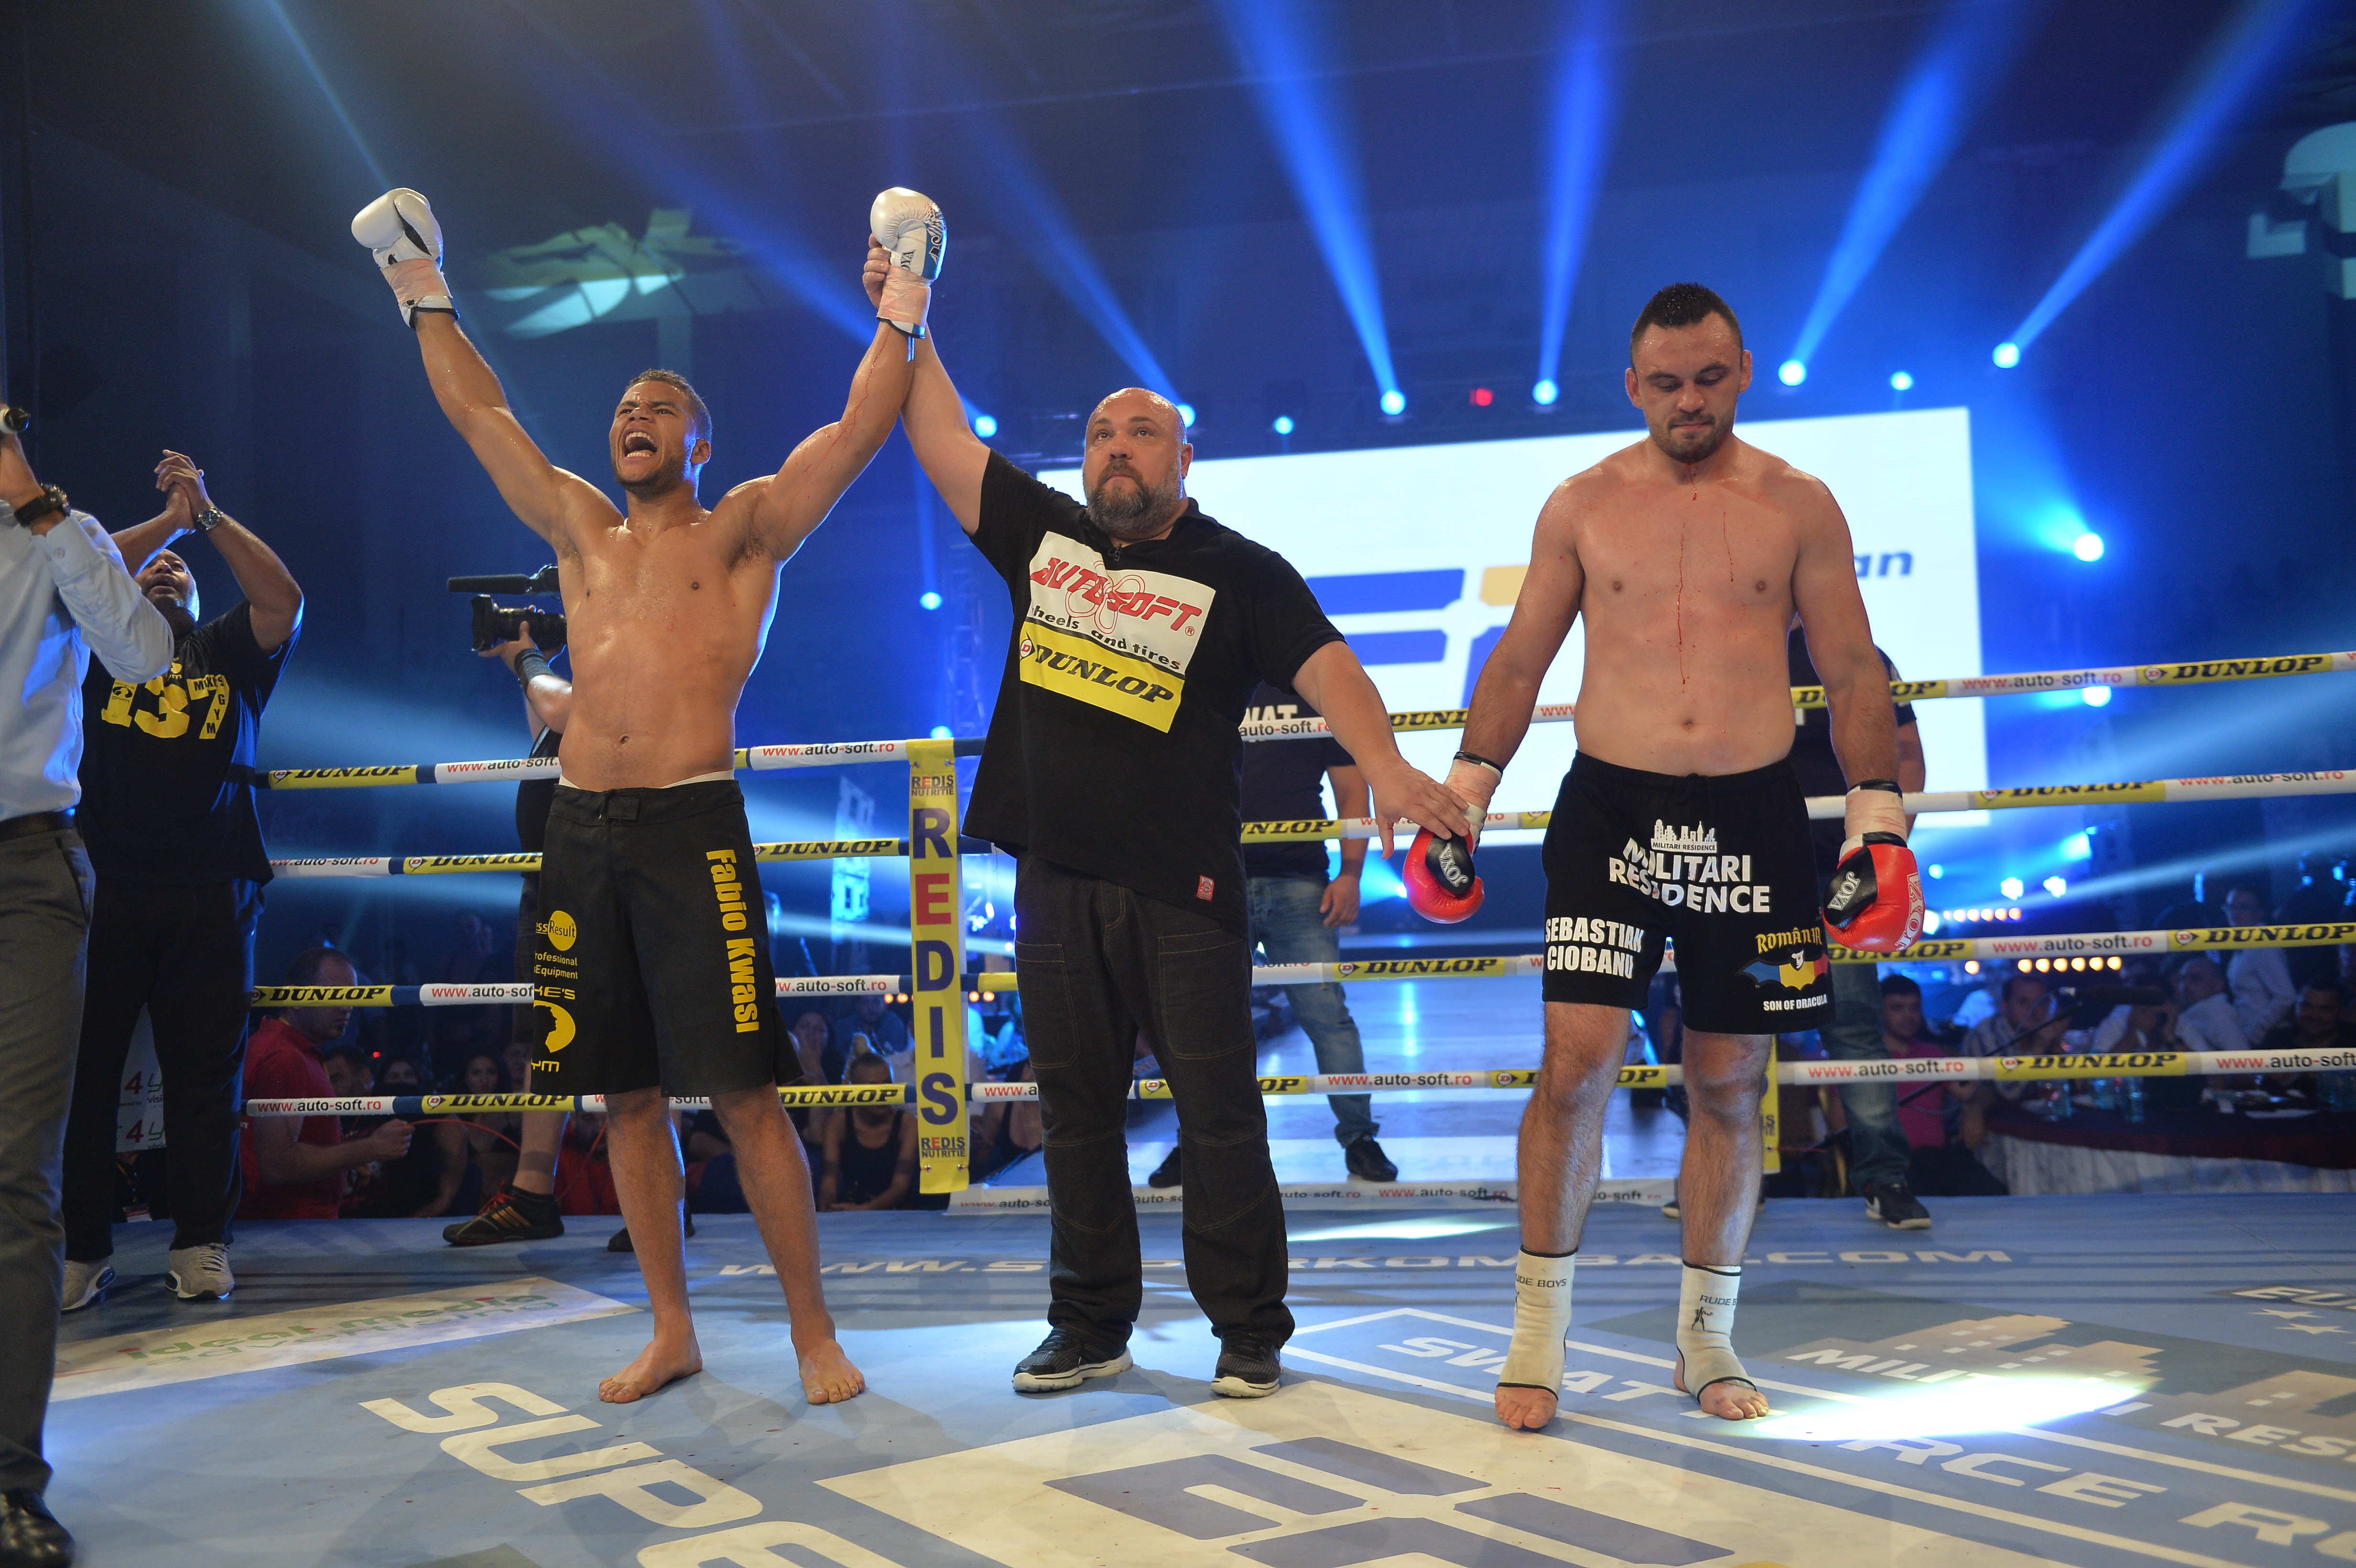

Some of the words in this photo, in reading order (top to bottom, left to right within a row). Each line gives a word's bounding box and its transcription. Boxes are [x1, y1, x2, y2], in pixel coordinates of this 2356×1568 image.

[901, 249, 916, 271] OYA
[1032, 605, 1080, 630] heels
[1091, 629, 1127, 650] and
[1133, 643, 1180, 670] tires
[1034, 645, 1174, 703] DUNLOP
[1962, 671, 2122, 690] www.auto-soft.ro
[2173, 656, 2324, 679] DUNLOP
[294, 766, 411, 779] DUNLOP
[447, 757, 558, 773] www.auto-soft.
[763, 742, 894, 757] www.auto-soft.ro
[911, 775, 954, 788] REDIS
[911, 787, 954, 796] NUTRITIE
[270, 857, 379, 866] ww.auto-soft.ro
[770, 840, 893, 856] DUNLOP
[1243, 821, 1335, 834] NLOP
[1623, 837, 1751, 882] MILITARI
[1652, 841, 1680, 849] MILITARI
[706, 849, 747, 931] Fabio
[1609, 857, 1770, 914] RESIDENCE
[1545, 916, 1644, 953] SEBASTIAN
[1992, 935, 2152, 953] www.auto-soft.ro
[2204, 925, 2355, 943] DUNLOP
[535, 951, 578, 967] rofessional
[913, 808, 958, 1125] REDIS
[1547, 945, 1634, 980] CIOBANU
[270, 988, 386, 1001] DUNLOP
[1363, 959, 1498, 974] DUNLOP
[1763, 1000, 1782, 1012] SON
[1784, 999, 1795, 1010] OF
[1796, 994, 1828, 1009] DRACULA
[1808, 1060, 1964, 1078] www.auto-soft.ro
[2029, 1055, 2178, 1069] DUNLOP
[257, 1099, 382, 1112] www.auto-soft.ro
[449, 1093, 568, 1107] DUNLOP
[780, 1089, 898, 1105] DUNLOP
[1328, 1073, 1472, 1086] www.auto-soft.ro
[921, 1136, 965, 1148] REDIS
[921, 1148, 966, 1158] NUTRITIE
[1516, 1273, 1534, 1286] UDE
[1537, 1278, 1567, 1288] BOYS
[339, 1294, 550, 1331] media
[1699, 1295, 1731, 1306] RUDE
[2160, 1412, 2356, 1463] RES
